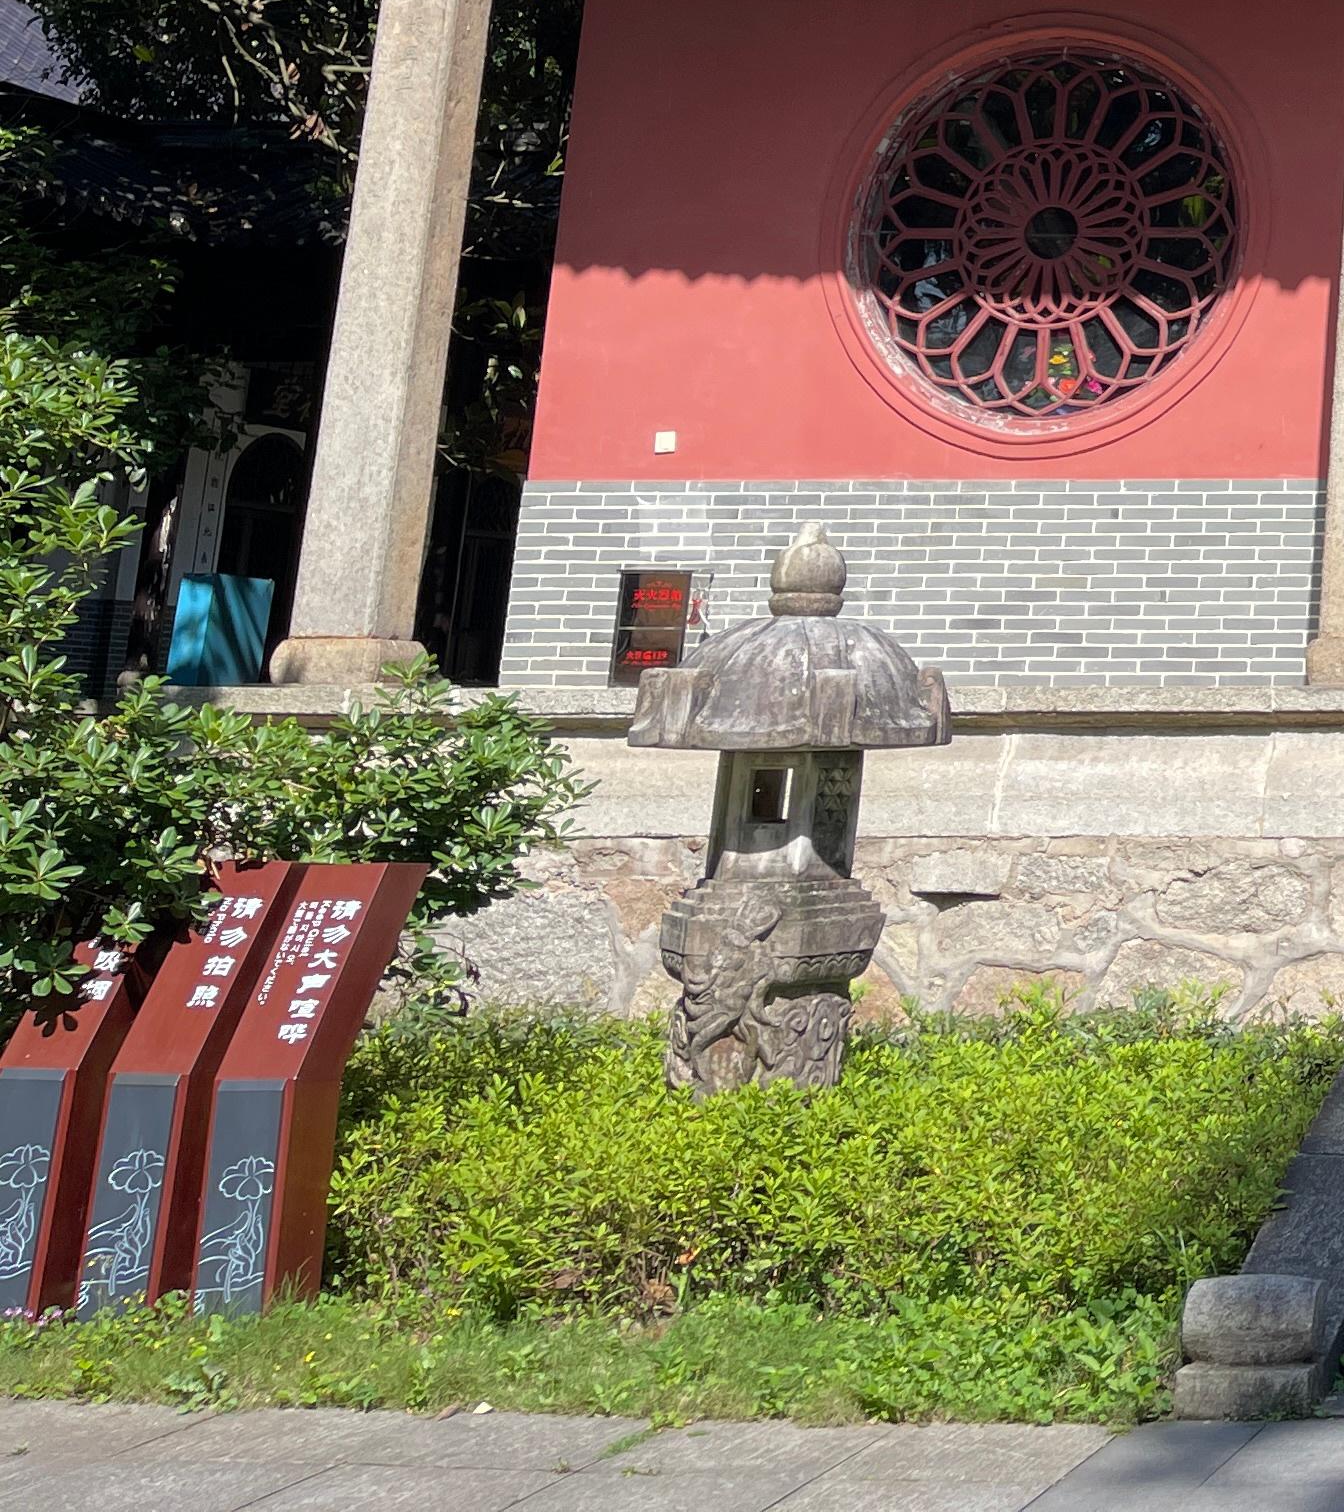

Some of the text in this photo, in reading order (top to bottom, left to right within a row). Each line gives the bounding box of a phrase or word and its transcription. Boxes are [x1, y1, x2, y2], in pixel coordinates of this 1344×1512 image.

[186, 896, 264, 1009] 请勿拍照
[278, 899, 363, 1045] 请勿大声喧哗
